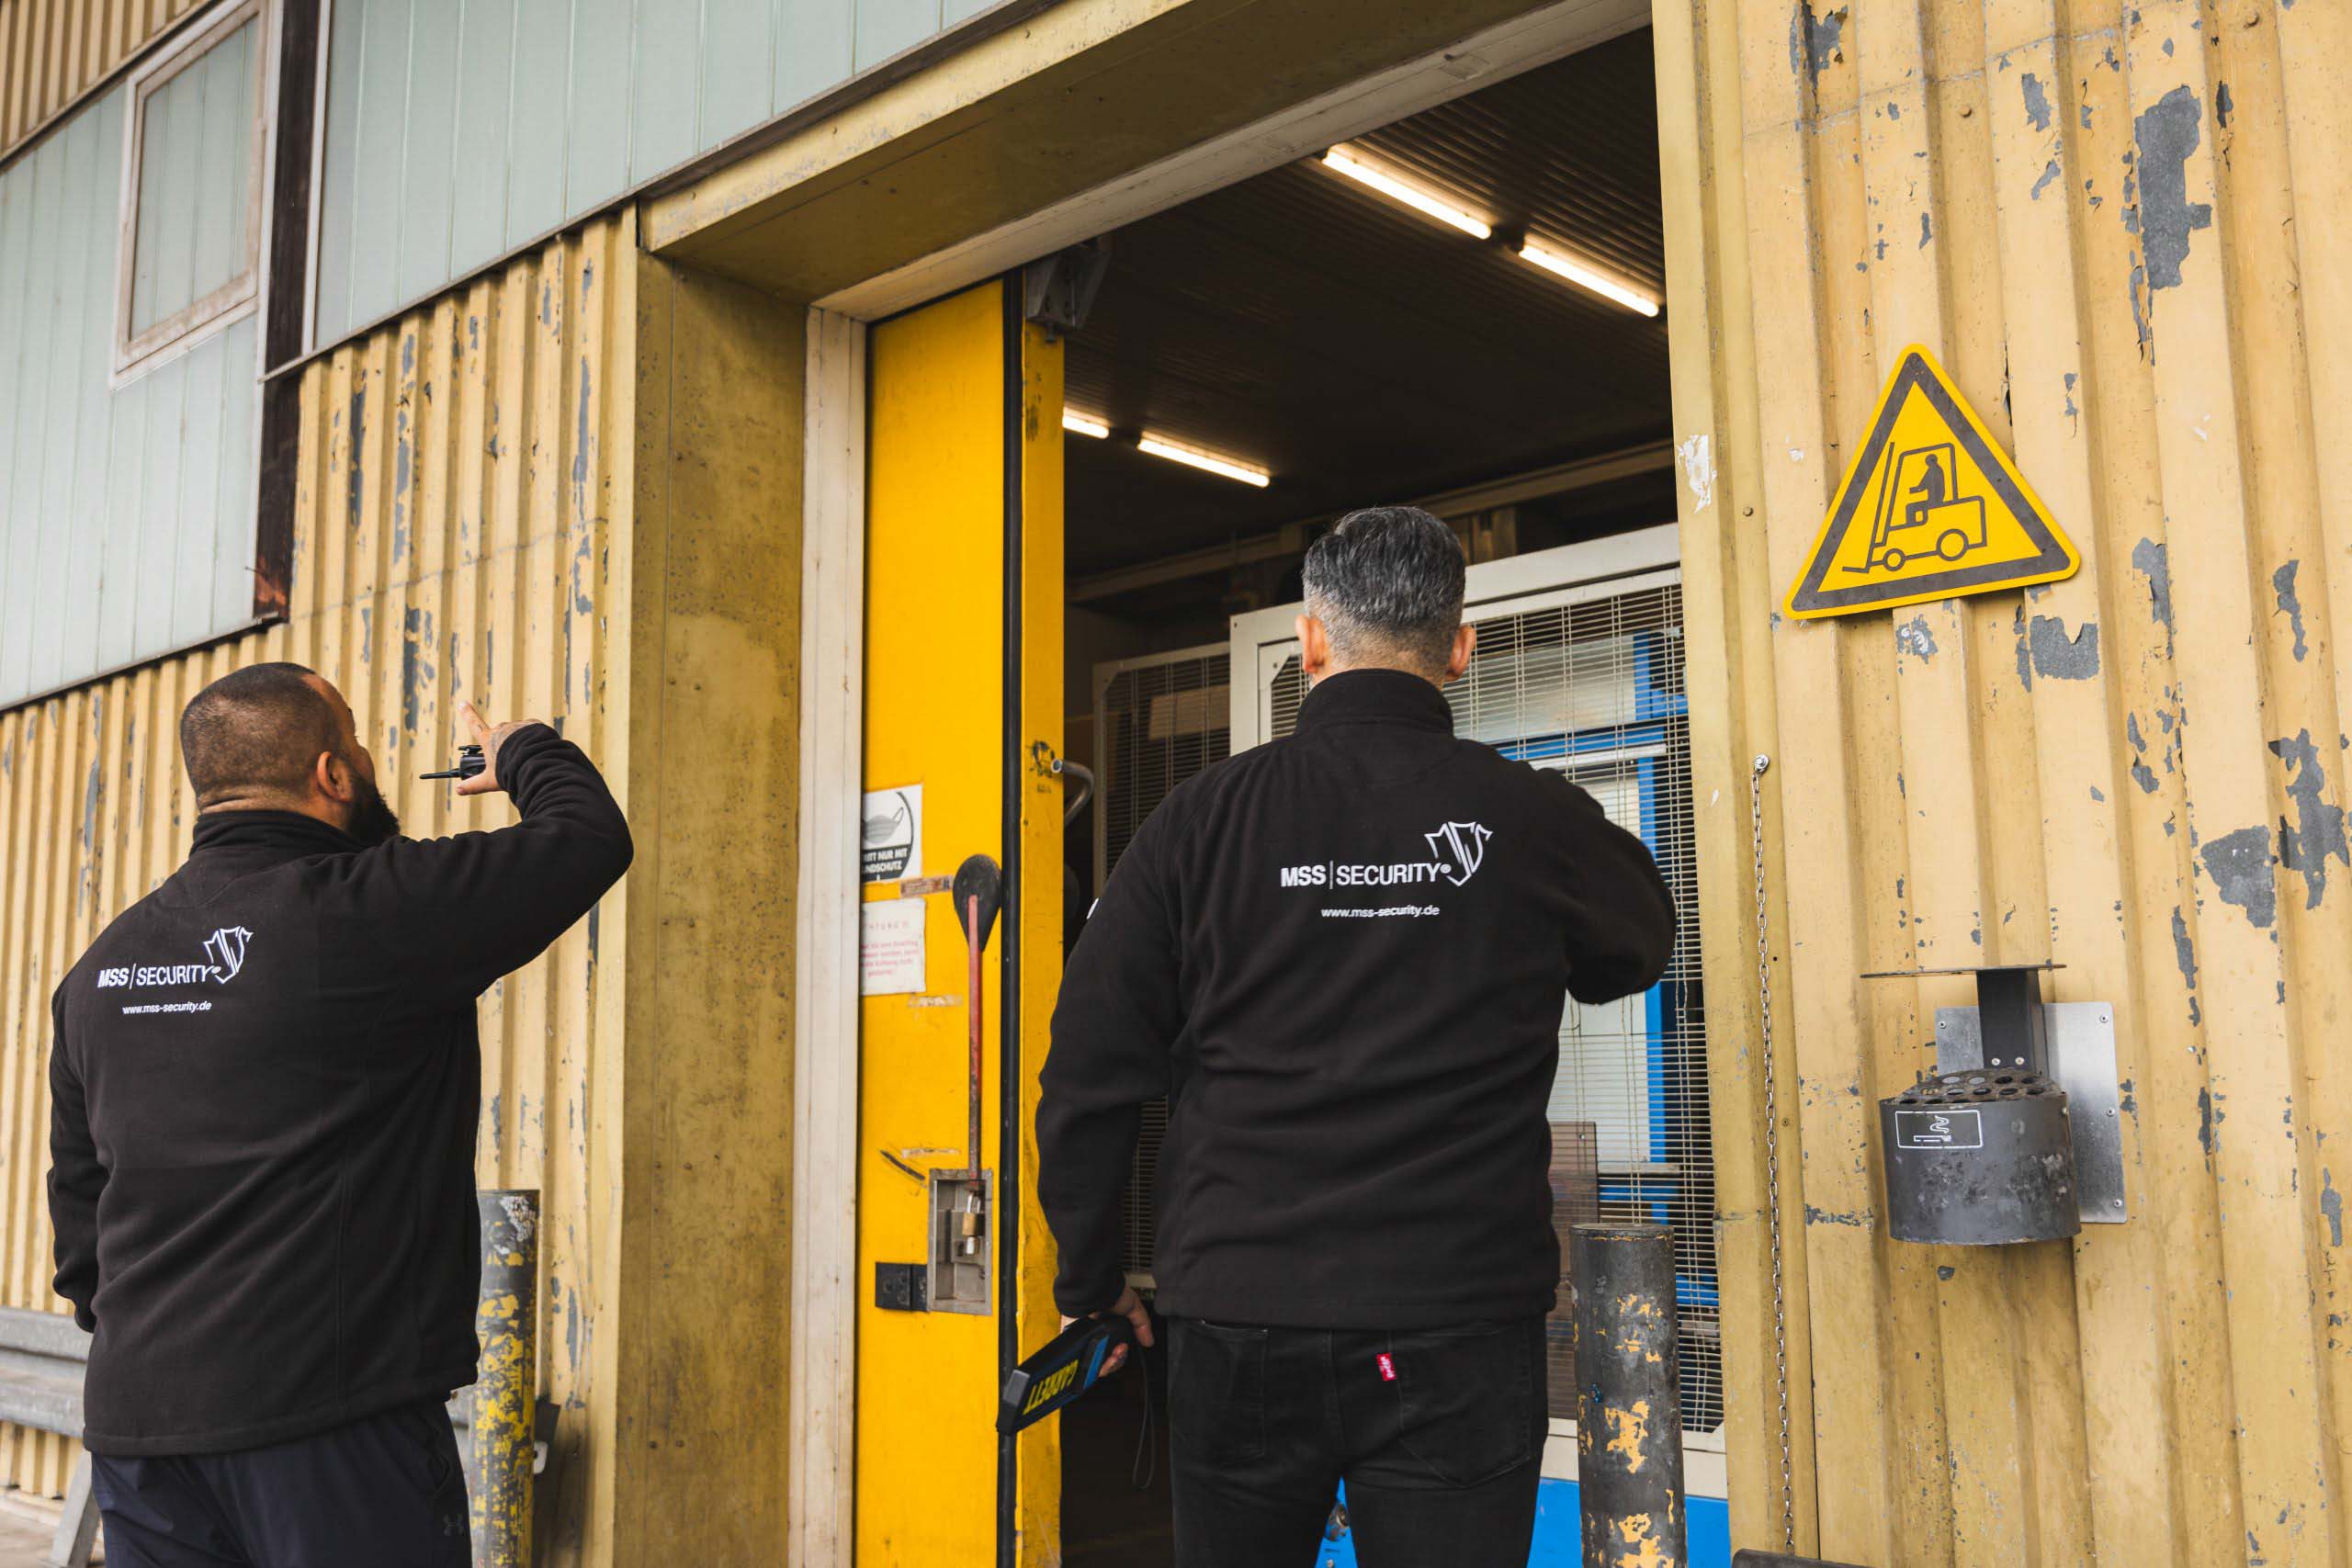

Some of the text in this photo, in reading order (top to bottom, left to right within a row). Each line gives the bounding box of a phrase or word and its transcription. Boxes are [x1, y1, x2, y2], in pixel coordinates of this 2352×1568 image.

[1280, 864, 1327, 888] MSS
[1320, 904, 1441, 919] www.mss-security.de
[96, 967, 130, 989] MSS
[121, 1000, 212, 1015] www.mss-security.de
